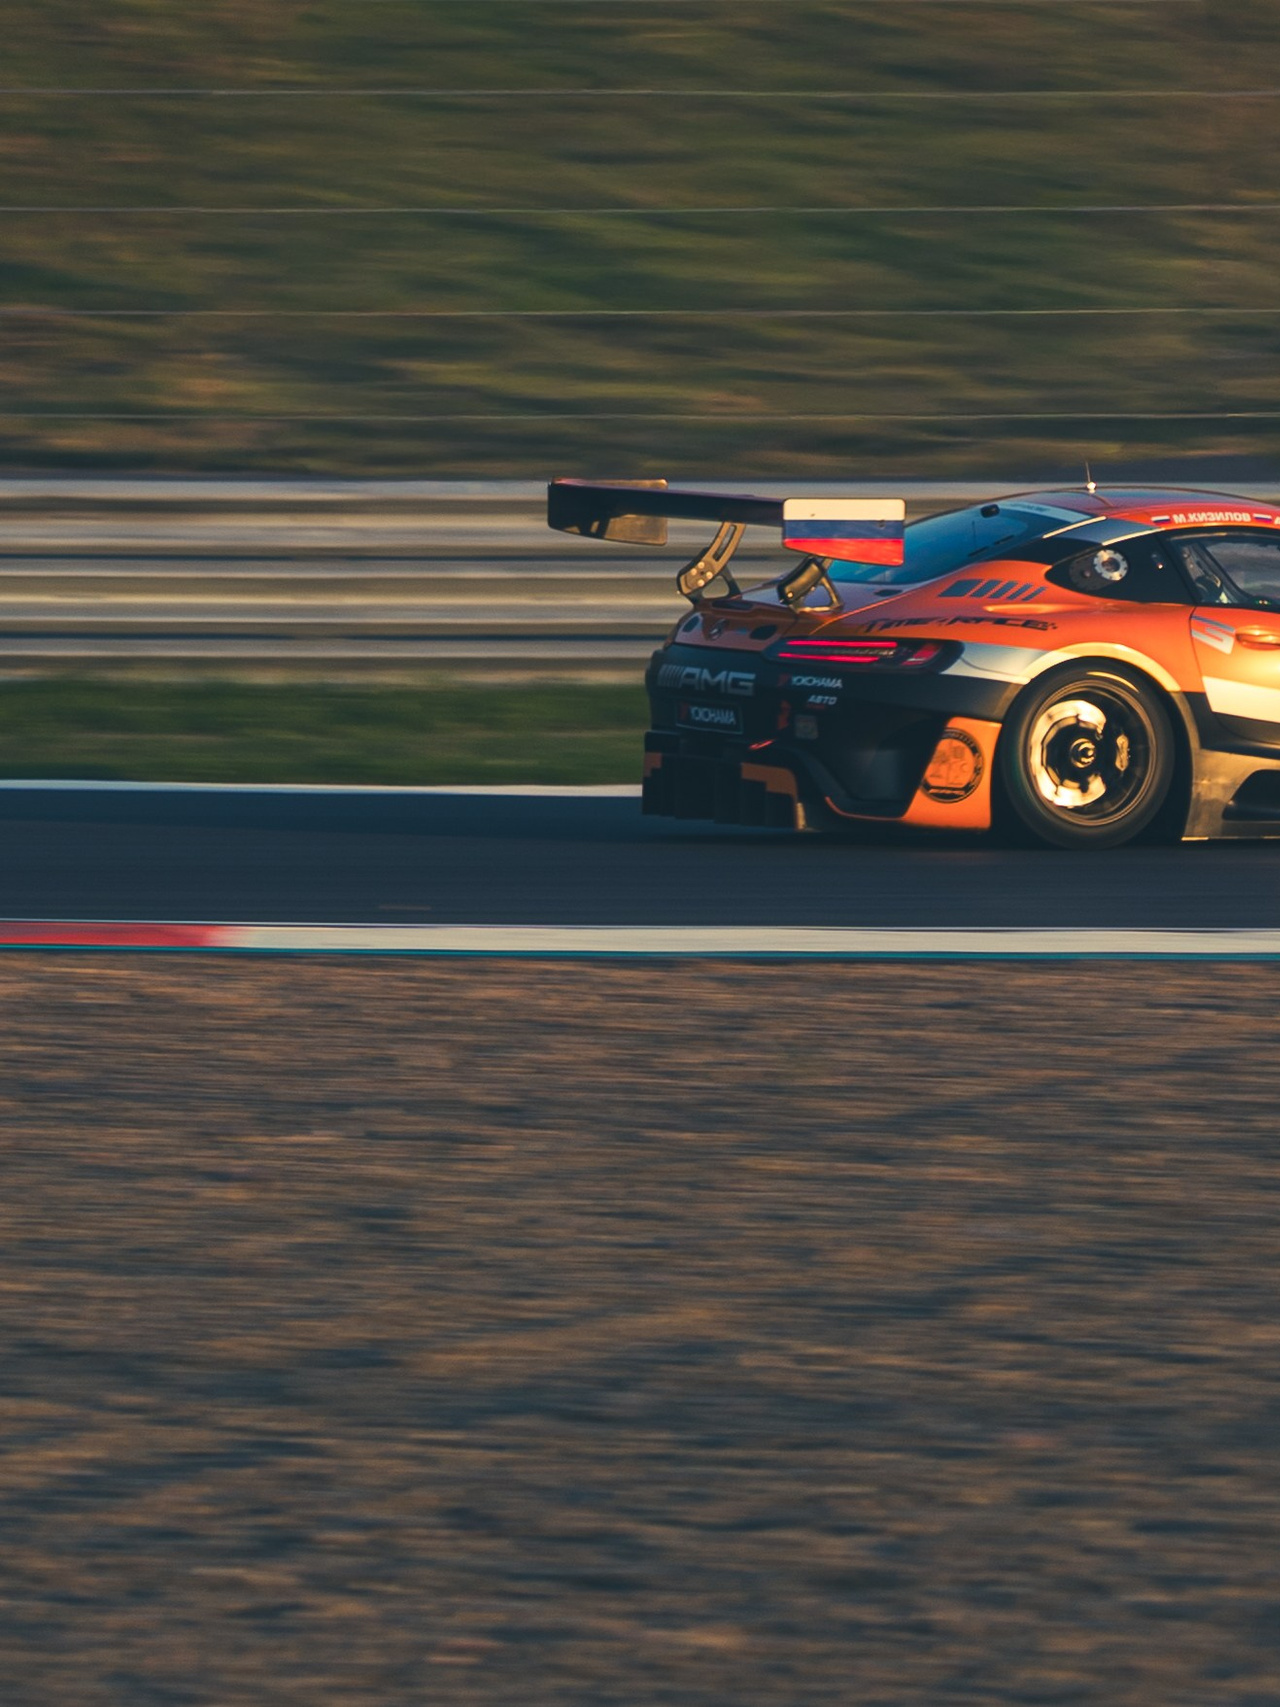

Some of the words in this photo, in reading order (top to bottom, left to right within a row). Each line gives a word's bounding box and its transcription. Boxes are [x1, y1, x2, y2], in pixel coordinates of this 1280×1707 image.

[679, 666, 756, 696] AMG
[791, 675, 844, 689] YOKOHAMA
[689, 706, 737, 726] YOKOHAMA
